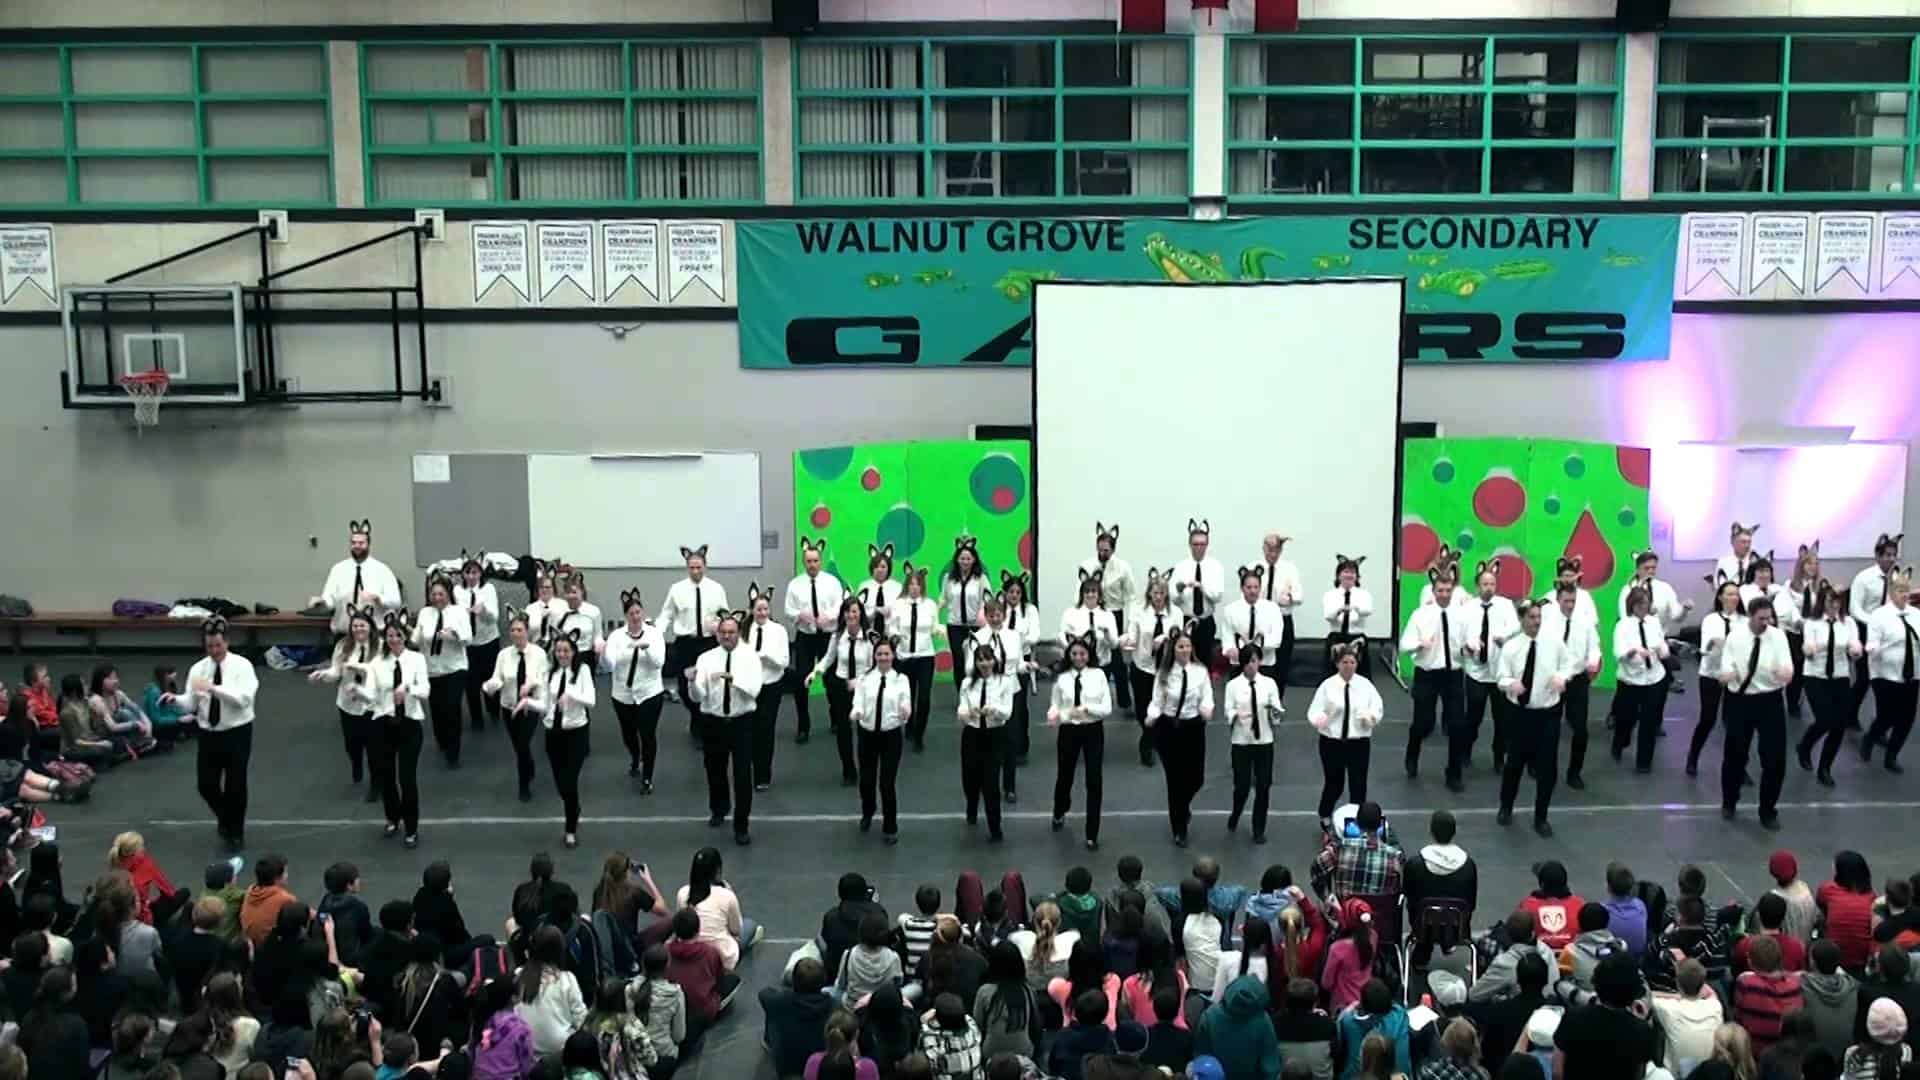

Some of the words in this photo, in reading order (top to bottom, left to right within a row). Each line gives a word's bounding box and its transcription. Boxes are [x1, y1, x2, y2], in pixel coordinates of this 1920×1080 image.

[795, 220, 974, 254] WALNUT
[986, 219, 1126, 253] GROVE
[1348, 217, 1600, 250] SECONDARY
